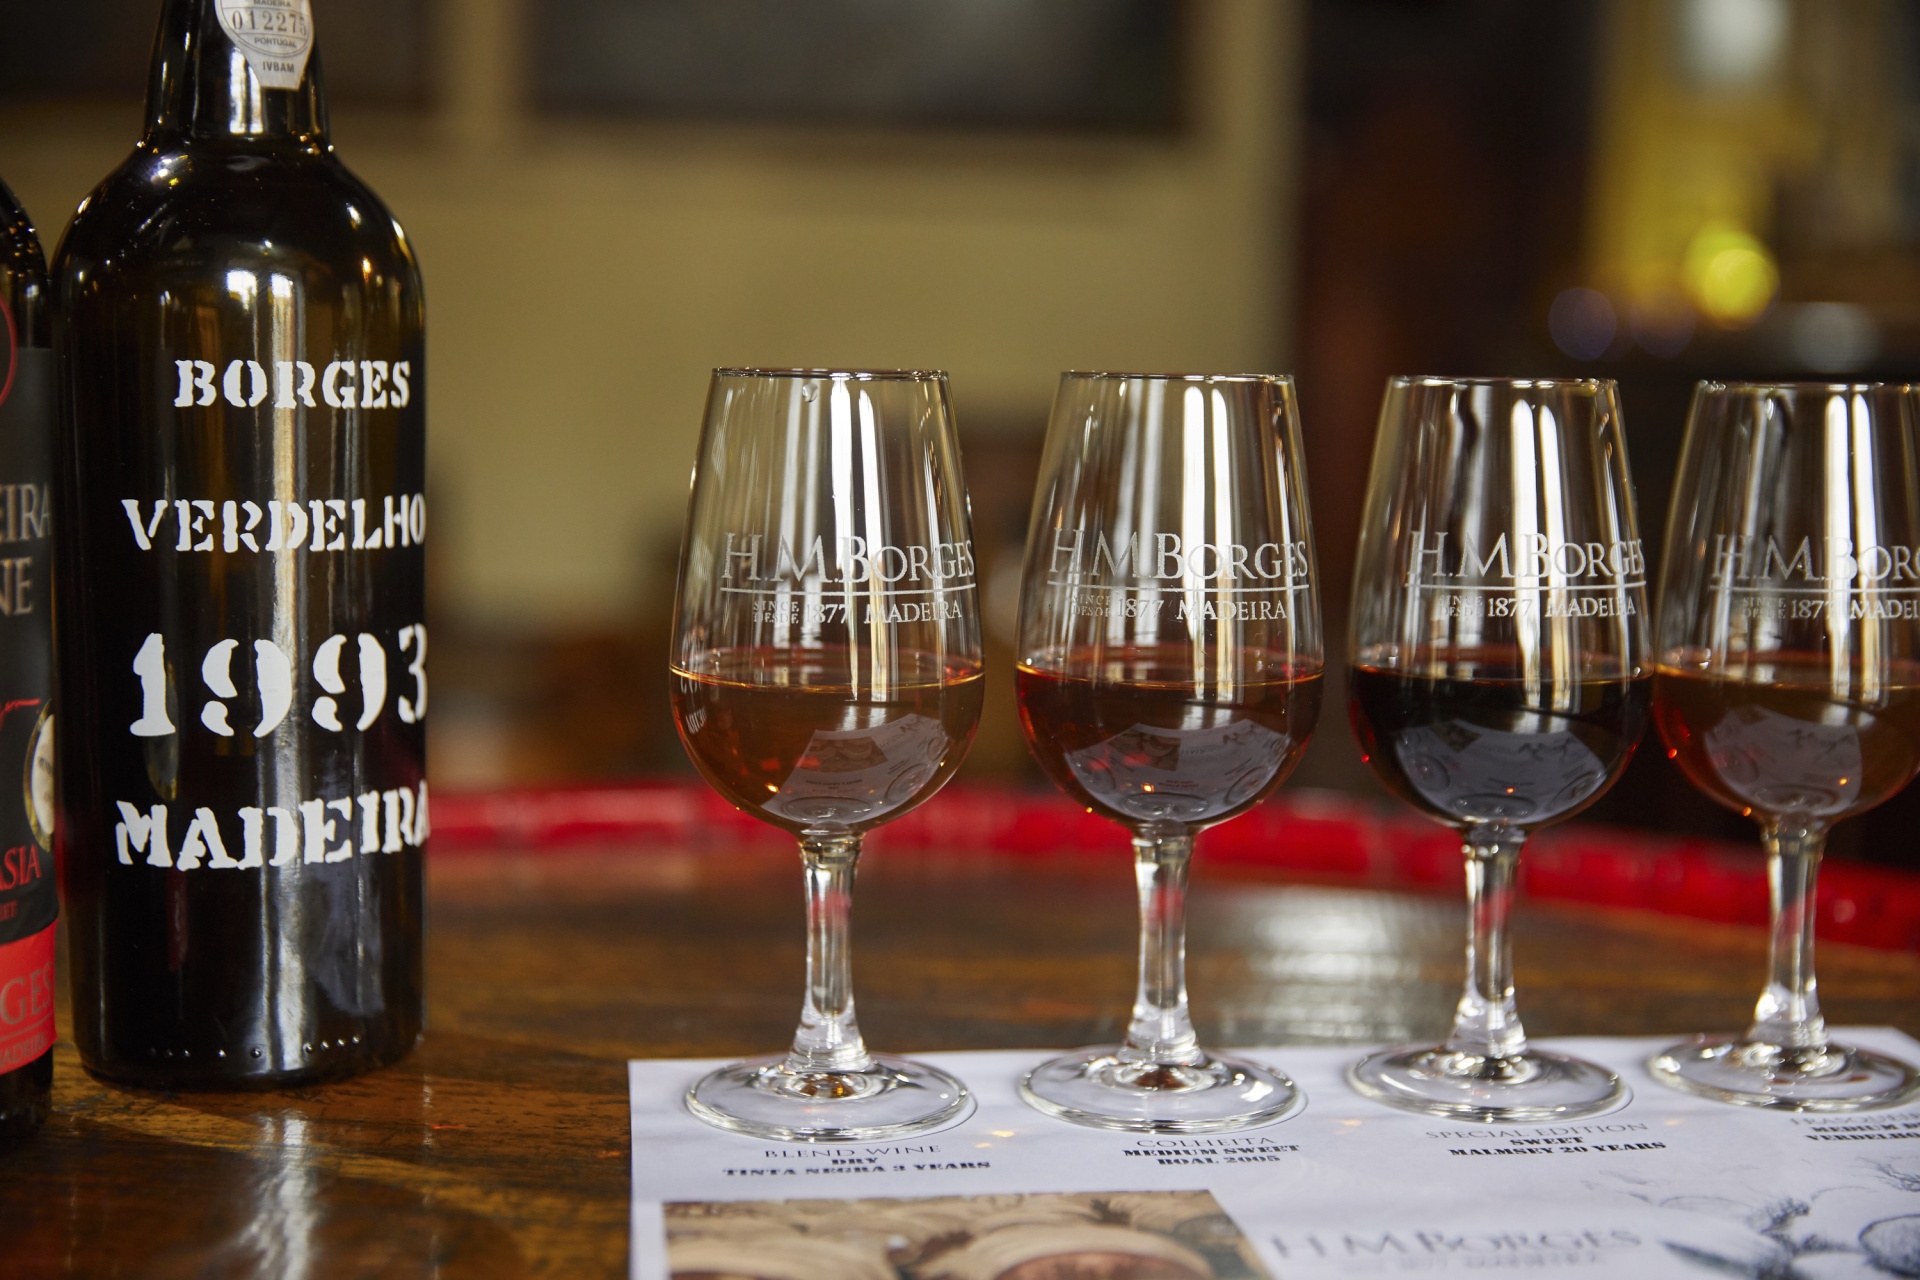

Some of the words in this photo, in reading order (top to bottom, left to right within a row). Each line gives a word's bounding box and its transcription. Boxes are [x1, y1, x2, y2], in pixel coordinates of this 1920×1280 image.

[254, 37, 297, 48] PORTUGAL
[262, 61, 295, 73] IVBAM
[174, 359, 411, 408] BORGES
[121, 493, 426, 553] VERDELHO
[864, 600, 962, 624] MADEIRA
[1117, 598, 1165, 618] 1877
[1176, 600, 1288, 620] MADEIRA
[1487, 597, 1533, 617] 1877
[1544, 595, 1637, 617] MADEIRA
[130, 623, 428, 738] 1993
[115, 780, 430, 871] MADEIRA
[1425, 1129, 1523, 1140] SPECIAL
[1534, 1122, 1649, 1138] EDITION
[1136, 1137, 1276, 1148] COLHEITA
[1448, 1147, 1554, 1156] MALMSEY
[1561, 1146, 1588, 1154] 20
[1593, 1141, 1667, 1152] YEARS
[1509, 1136, 1583, 1146] SWEET
[765, 1149, 856, 1158] BLEND
[865, 1144, 942, 1156] WINE
[1122, 1149, 1218, 1157] MEDIUM
[1224, 1145, 1300, 1153] SWEET
[831, 1157, 879, 1165] DRY
[1157, 1156, 1219, 1165] BOAL
[1225, 1155, 1281, 1163] 2005
[722, 1168, 797, 1176] TINTA
[805, 1165, 886, 1175] NEGRA
[912, 1161, 991, 1171] YEARS
